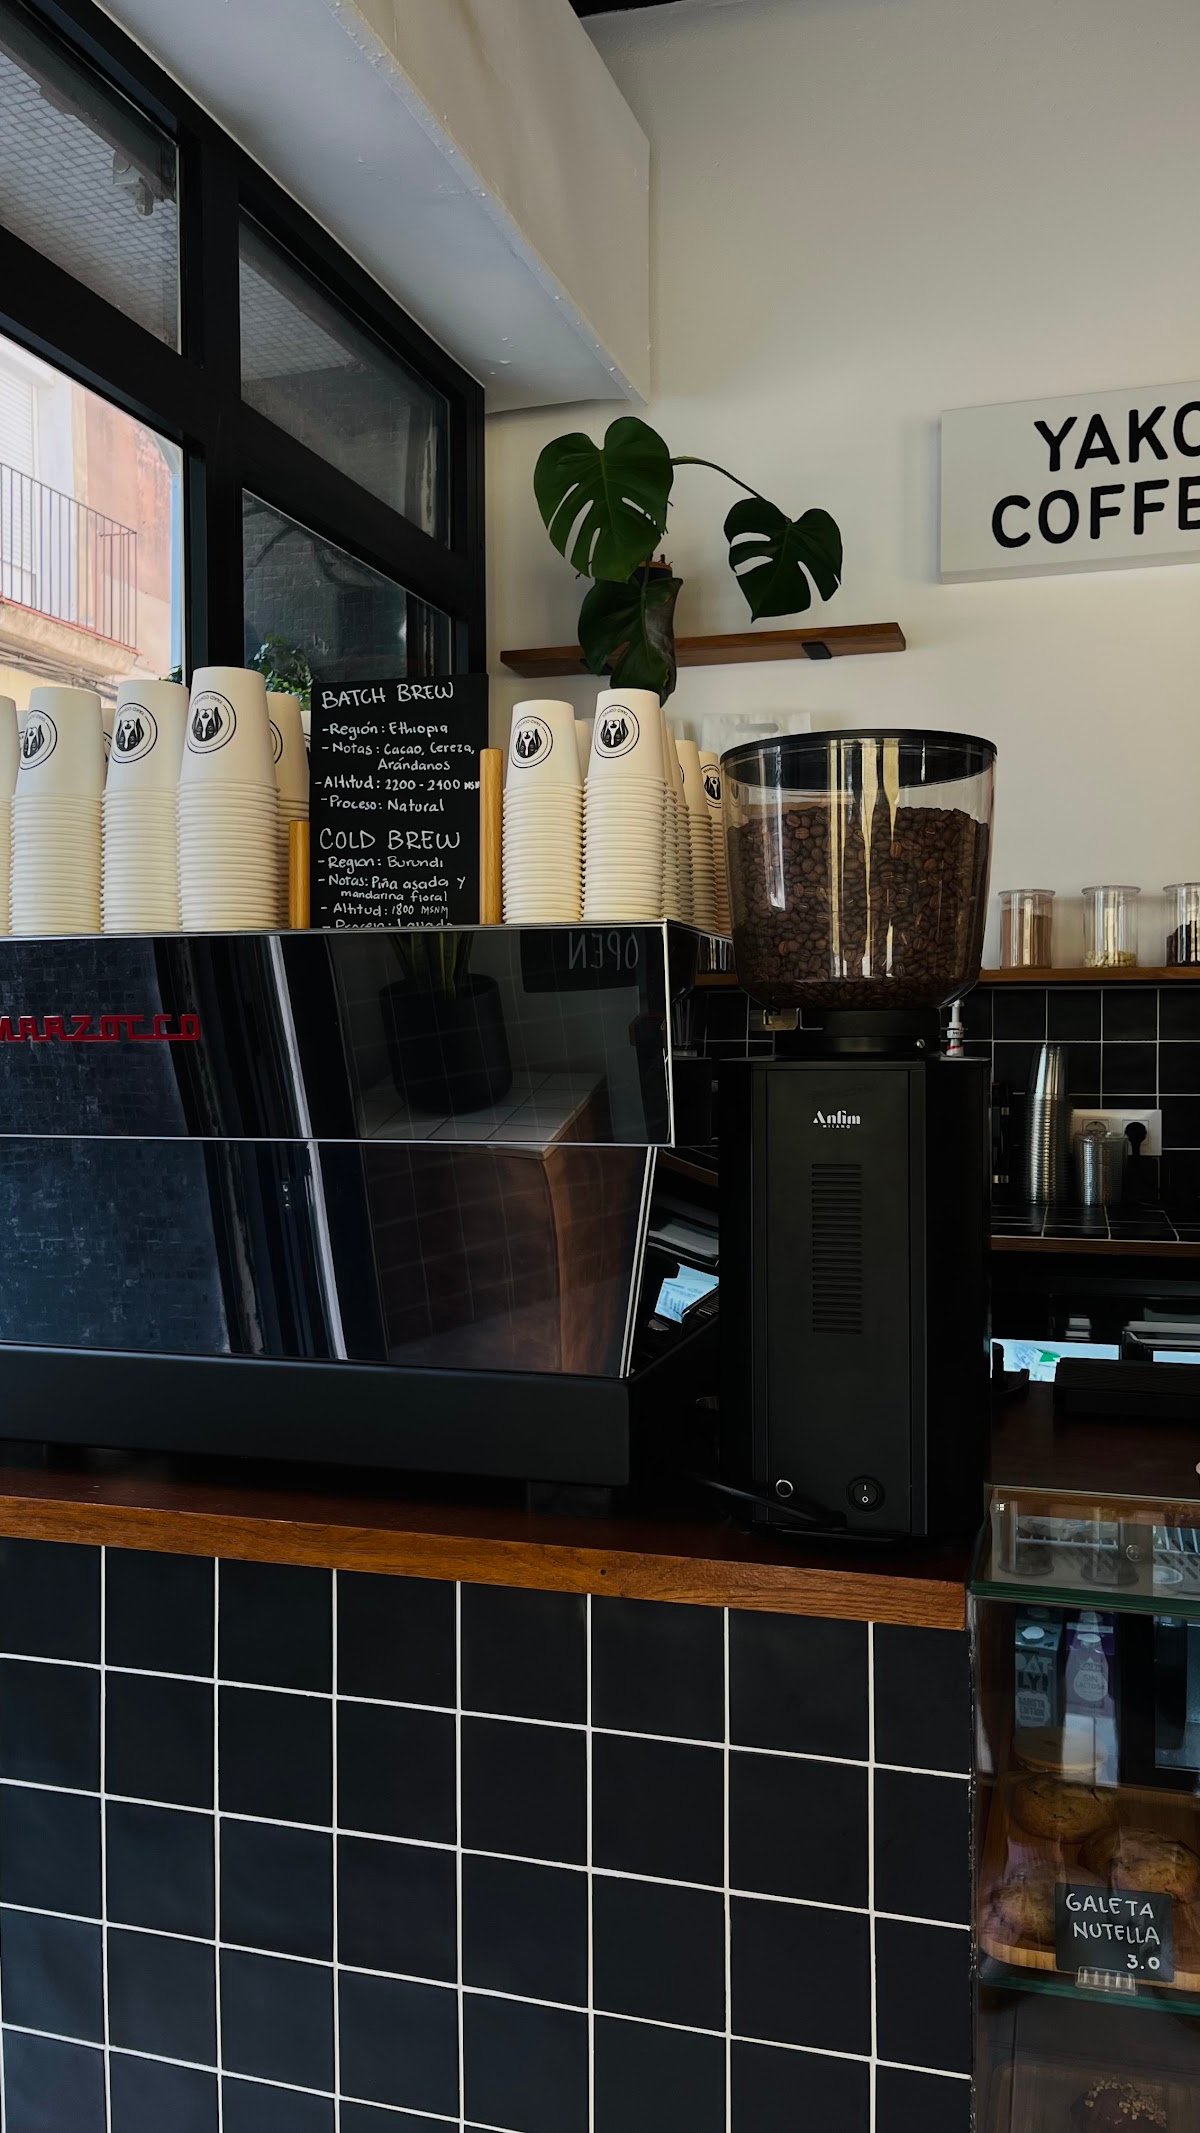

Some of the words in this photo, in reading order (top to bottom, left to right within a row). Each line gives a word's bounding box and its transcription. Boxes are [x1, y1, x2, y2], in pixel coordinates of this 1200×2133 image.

[321, 687, 387, 709] BATCH
[396, 682, 455, 702] BREW
[388, 721, 448, 738] Ethiopia
[383, 743, 425, 756] Cacao,
[430, 741, 475, 755] Cereza,
[377, 756, 451, 771] Arándanos
[385, 778, 416, 791] 2200
[426, 779, 461, 791] 2400
[387, 798, 445, 812] Natural
[319, 827, 376, 850] COLD
[387, 829, 461, 850] BREW
[387, 855, 444, 868] Burundi
[371, 875, 398, 890] Piña
[402, 875, 449, 890] asada
[340, 889, 404, 901] mandarina
[391, 902, 415, 916] 1800
[812, 1109, 861, 1125] Anfim
[1065, 1892, 1155, 1919] GALETA
[1073, 1921, 1161, 1945] NUTELLA
[1126, 1953, 1160, 1970] 3.0
